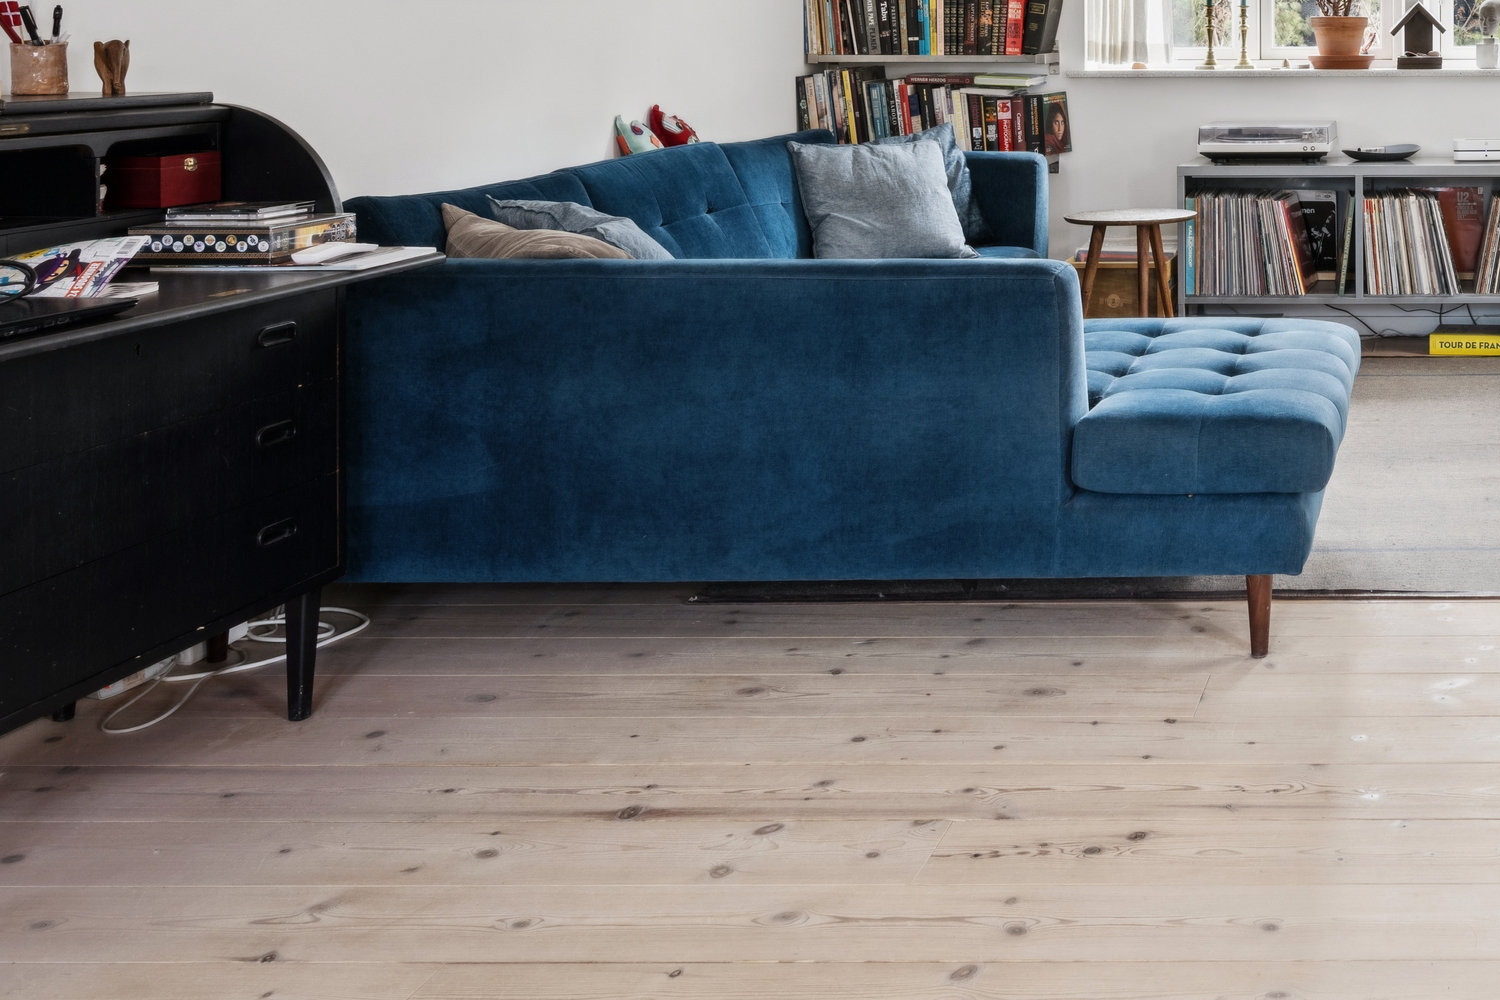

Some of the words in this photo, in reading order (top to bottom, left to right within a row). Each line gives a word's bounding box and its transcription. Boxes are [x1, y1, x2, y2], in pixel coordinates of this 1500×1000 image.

[1456, 191, 1470, 202] U2
[1439, 341, 1463, 349] TOUR
[1465, 341, 1477, 349] DE
